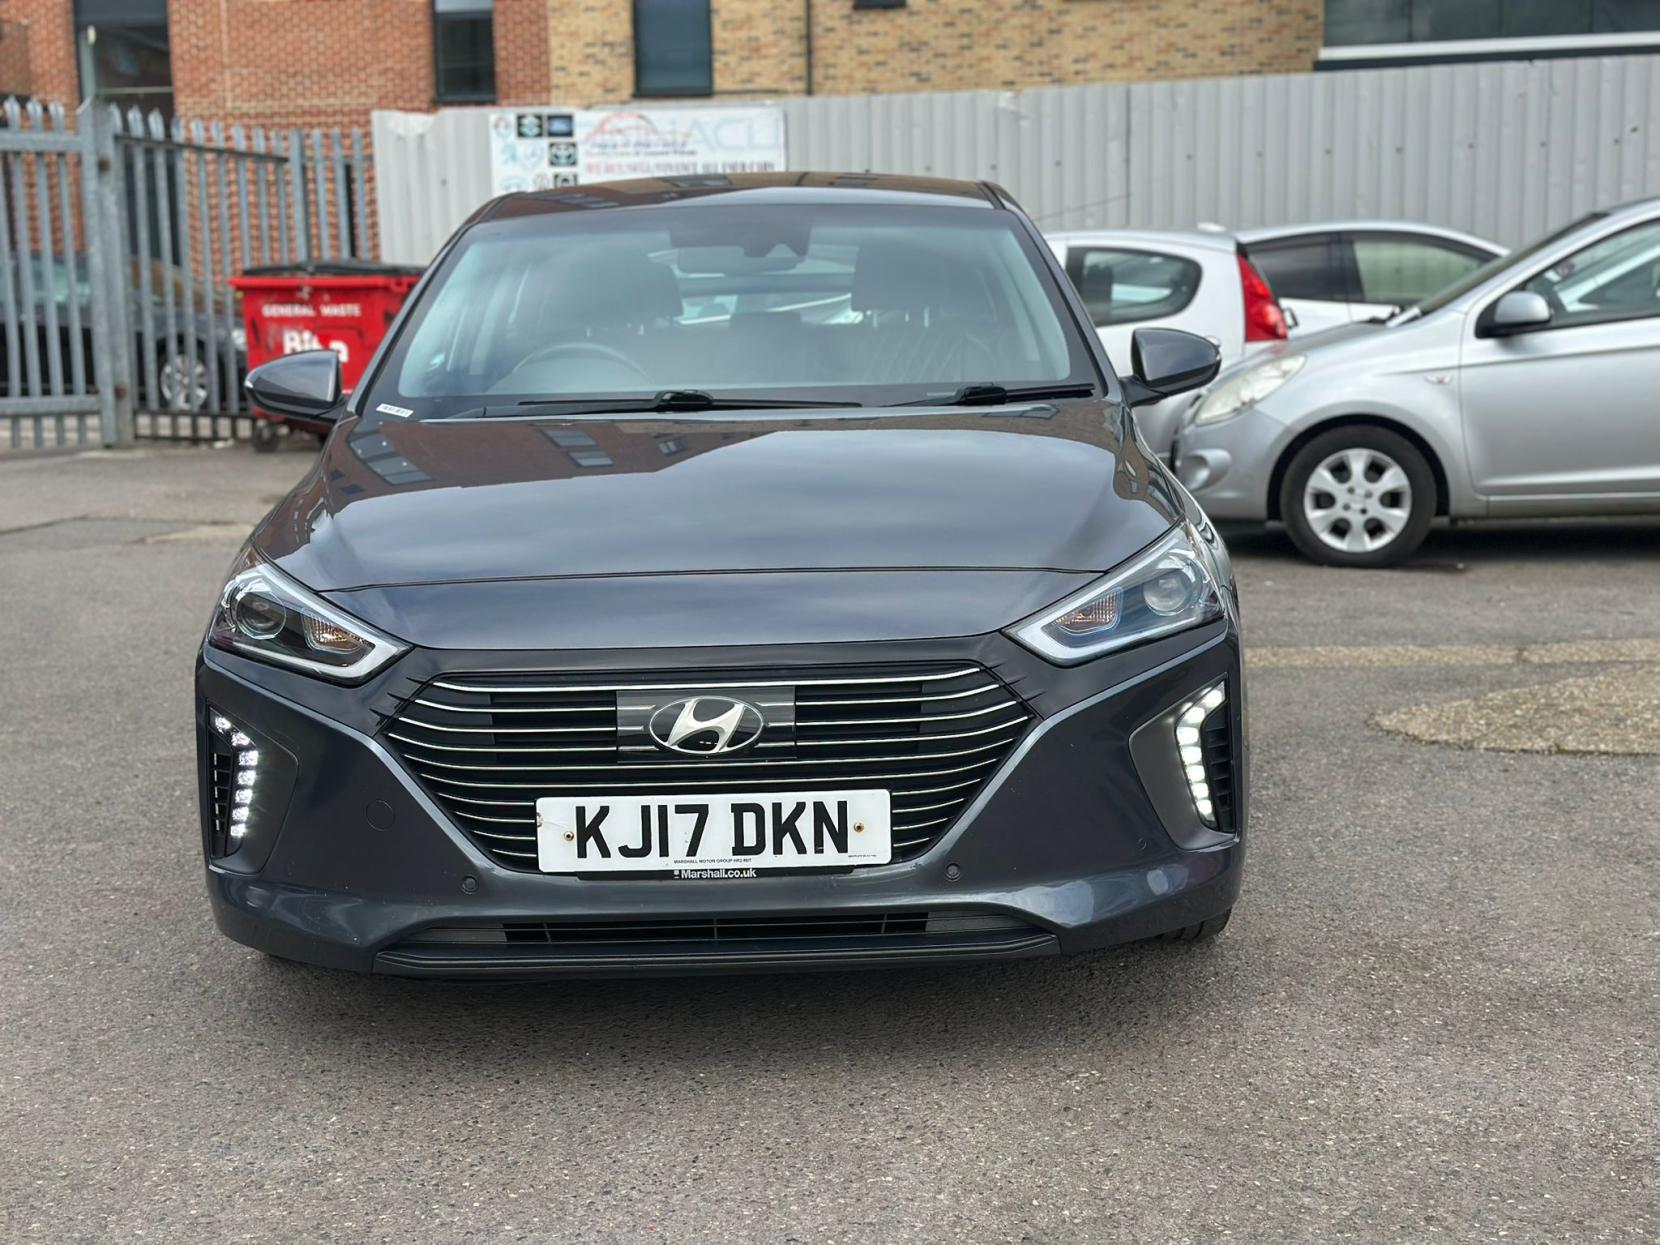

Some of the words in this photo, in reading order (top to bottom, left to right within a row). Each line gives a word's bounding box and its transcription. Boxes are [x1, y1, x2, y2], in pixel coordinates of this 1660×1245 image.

[262, 303, 316, 318] GENERAL
[320, 303, 361, 317] WASTE
[575, 803, 709, 859] KJ17
[730, 800, 848, 856] DKN
[681, 868, 757, 879] Marshall.co.uk
